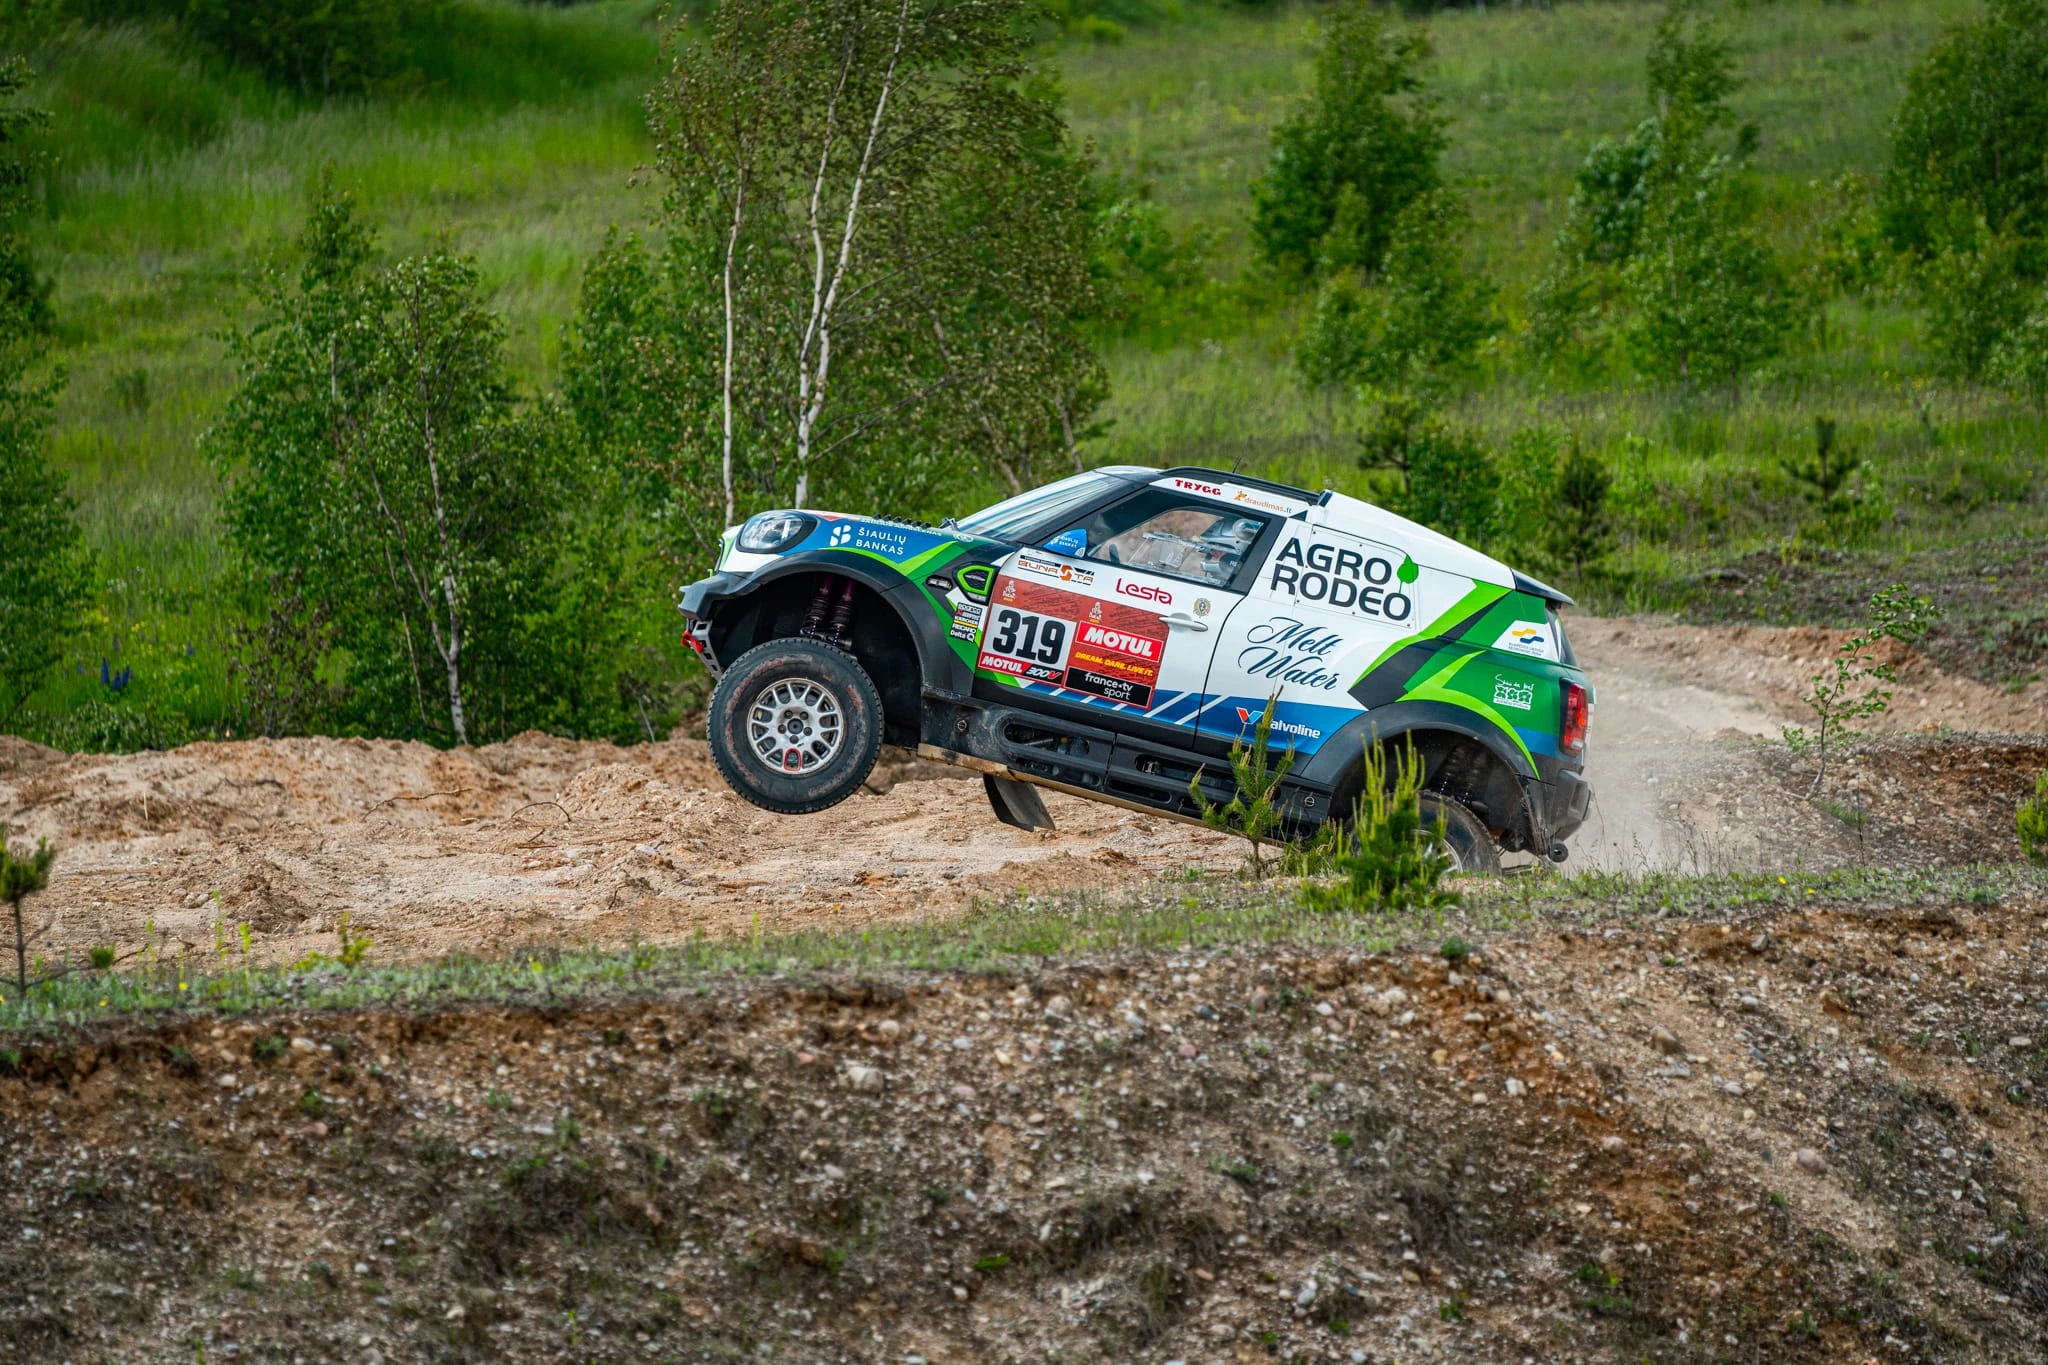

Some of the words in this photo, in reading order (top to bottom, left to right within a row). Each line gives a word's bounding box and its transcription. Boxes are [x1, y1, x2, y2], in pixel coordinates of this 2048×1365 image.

[1175, 479, 1221, 496] TRYGG
[1244, 497, 1292, 513] draudimas.lt
[855, 539, 904, 556] BANKAS
[857, 526, 907, 545] ŠIAULIŲ
[1275, 537, 1392, 586] AGRO
[1115, 577, 1173, 606] Lesta
[1270, 563, 1412, 621] RODEO
[992, 609, 1066, 665] 319
[1083, 626, 1153, 657] MOTUL
[1247, 616, 1344, 655] Melt
[981, 655, 1023, 673] MOTUL
[1025, 665, 1062, 679] 300V
[1075, 651, 1104, 665] DREAM.
[1104, 658, 1127, 670] DARE.
[1127, 664, 1144, 674] LIVE
[1238, 646, 1340, 690] Water
[1103, 687, 1131, 701] sport
